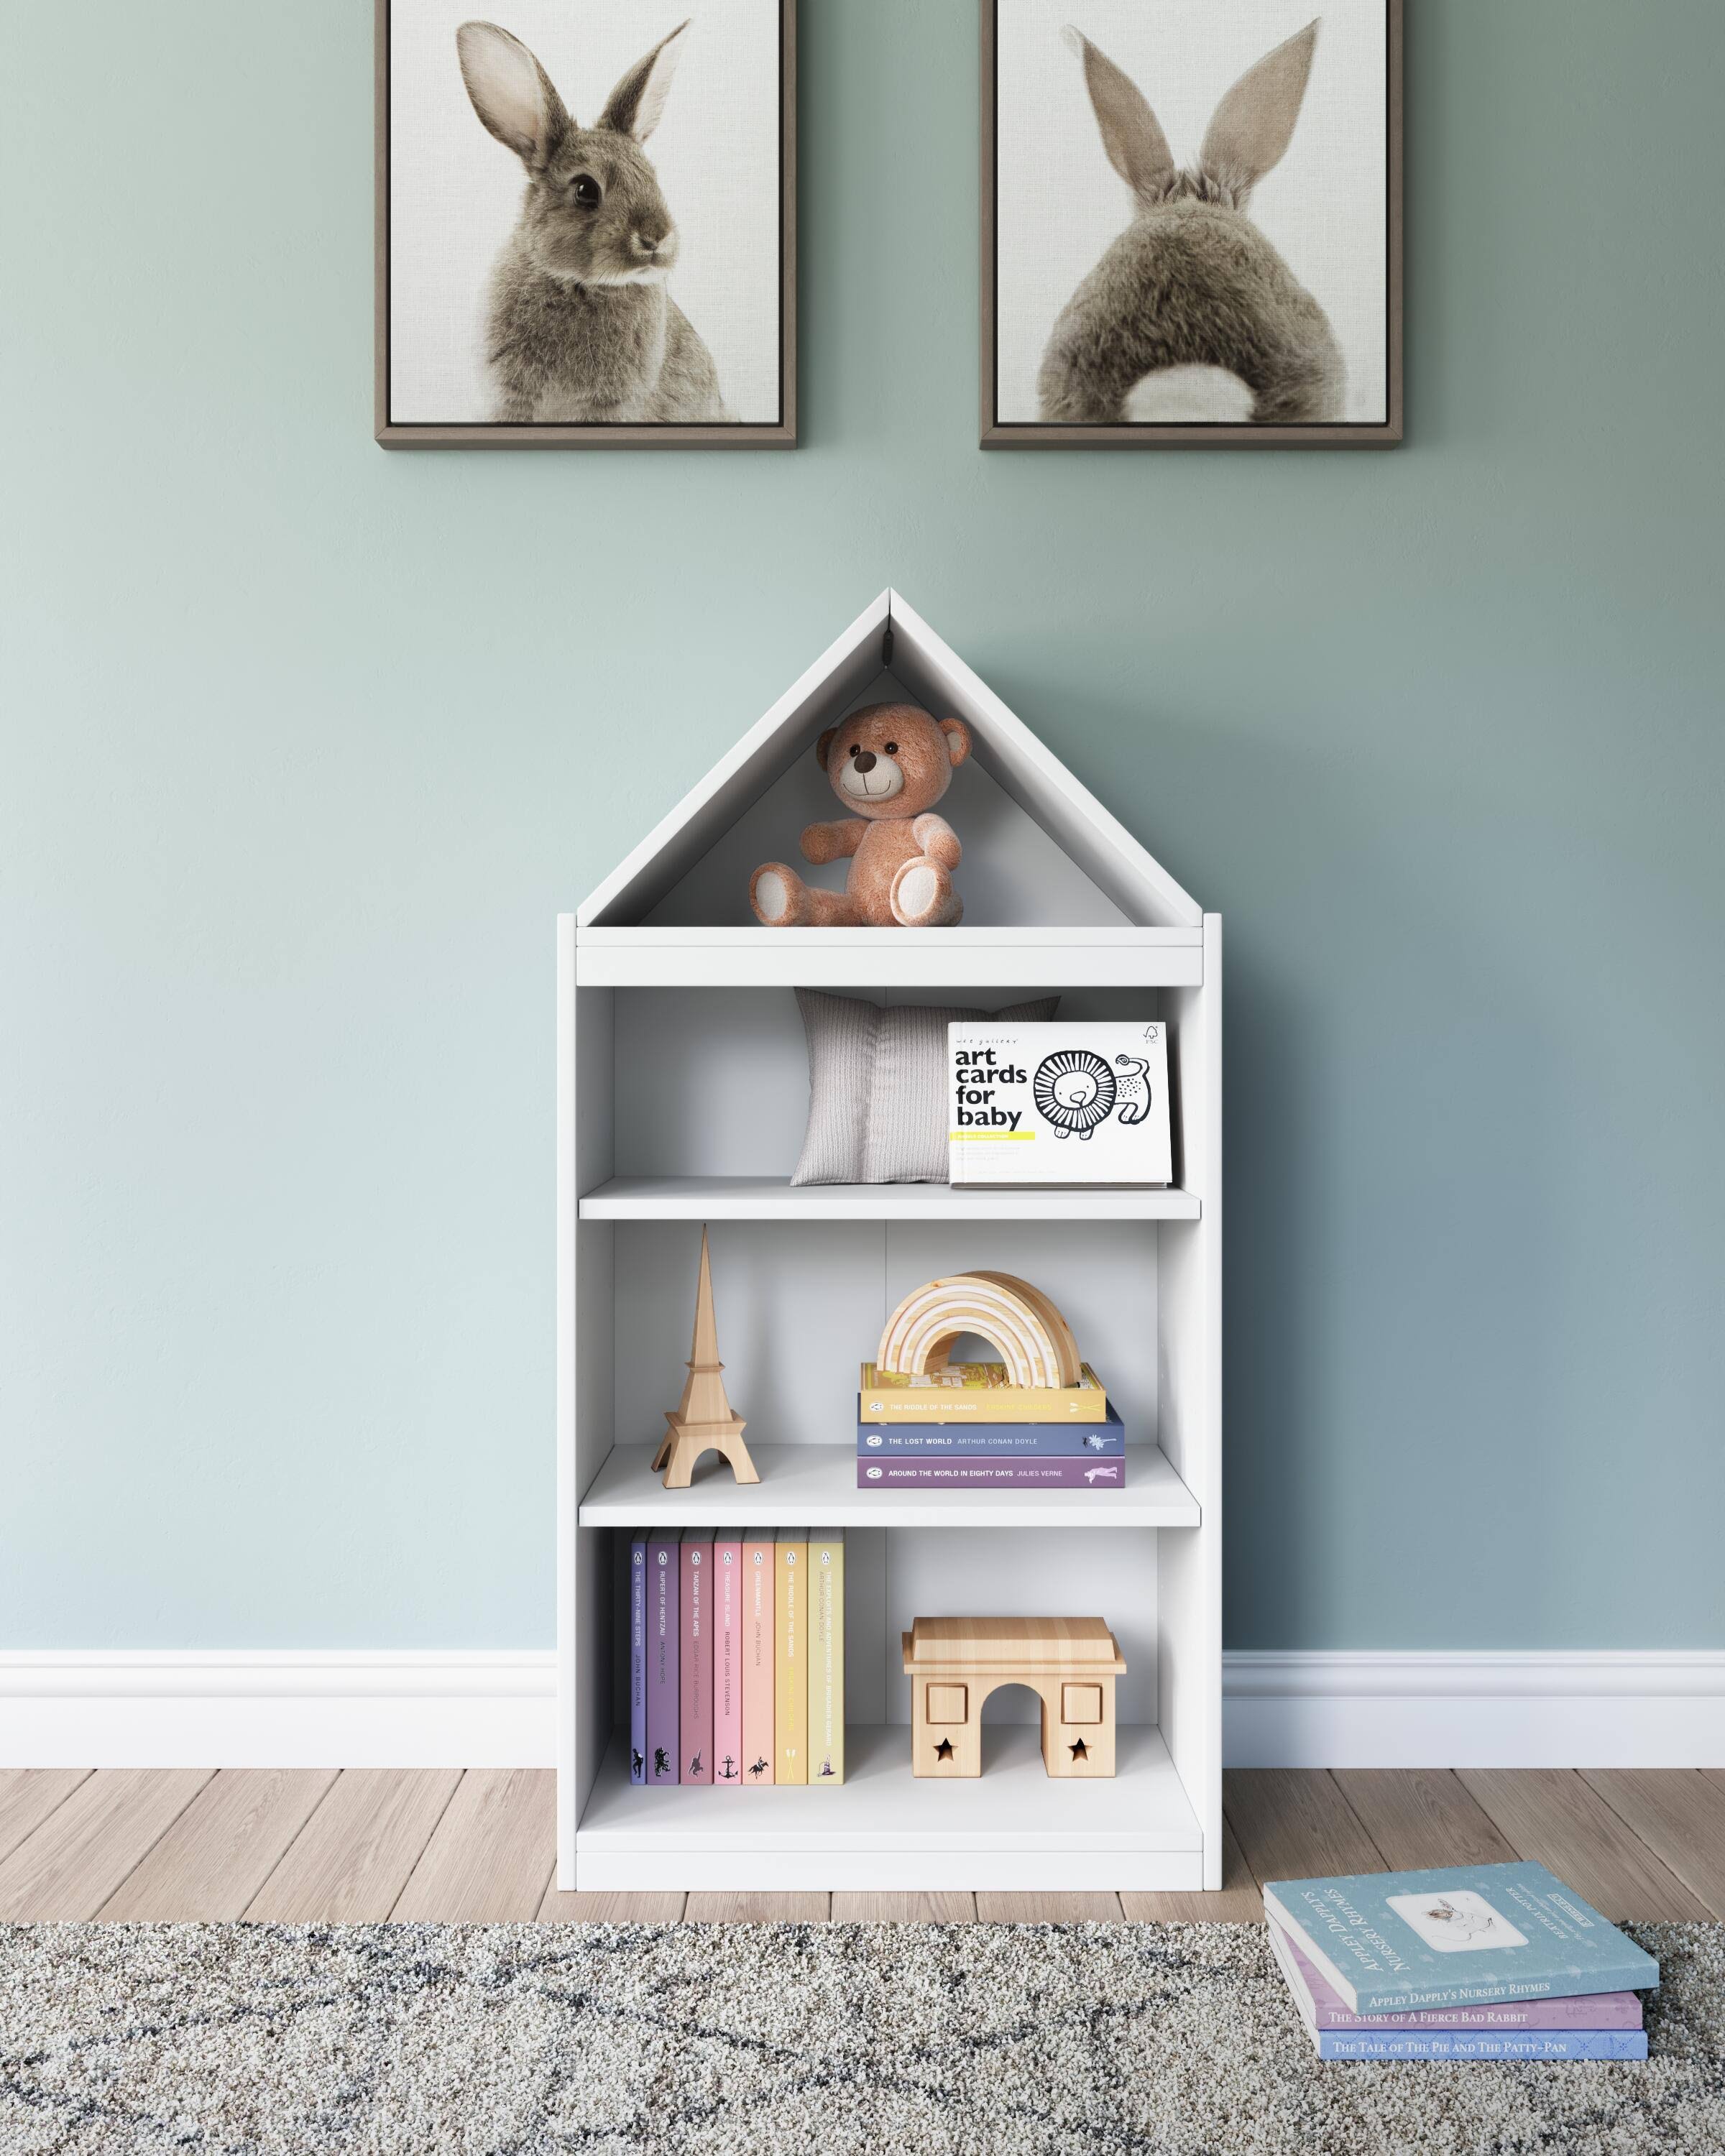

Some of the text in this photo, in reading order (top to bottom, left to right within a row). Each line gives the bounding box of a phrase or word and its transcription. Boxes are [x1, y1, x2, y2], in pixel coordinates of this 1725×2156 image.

[955, 1047, 997, 1066] art
[955, 1064, 1028, 1084] cards
[955, 1085, 995, 1105] for
[957, 1107, 1023, 1132] baby
[659, 1597, 666, 1606] OF
[693, 1597, 699, 1606] OF
[788, 1610, 794, 1620] OF
[1506, 1887, 1537, 1911] POTTER
[1323, 1888, 1412, 1972] NURSERY RHYMES
[1534, 1912, 1568, 1939] BEATRIX
[1338, 1934, 1385, 1973] APPLEY
